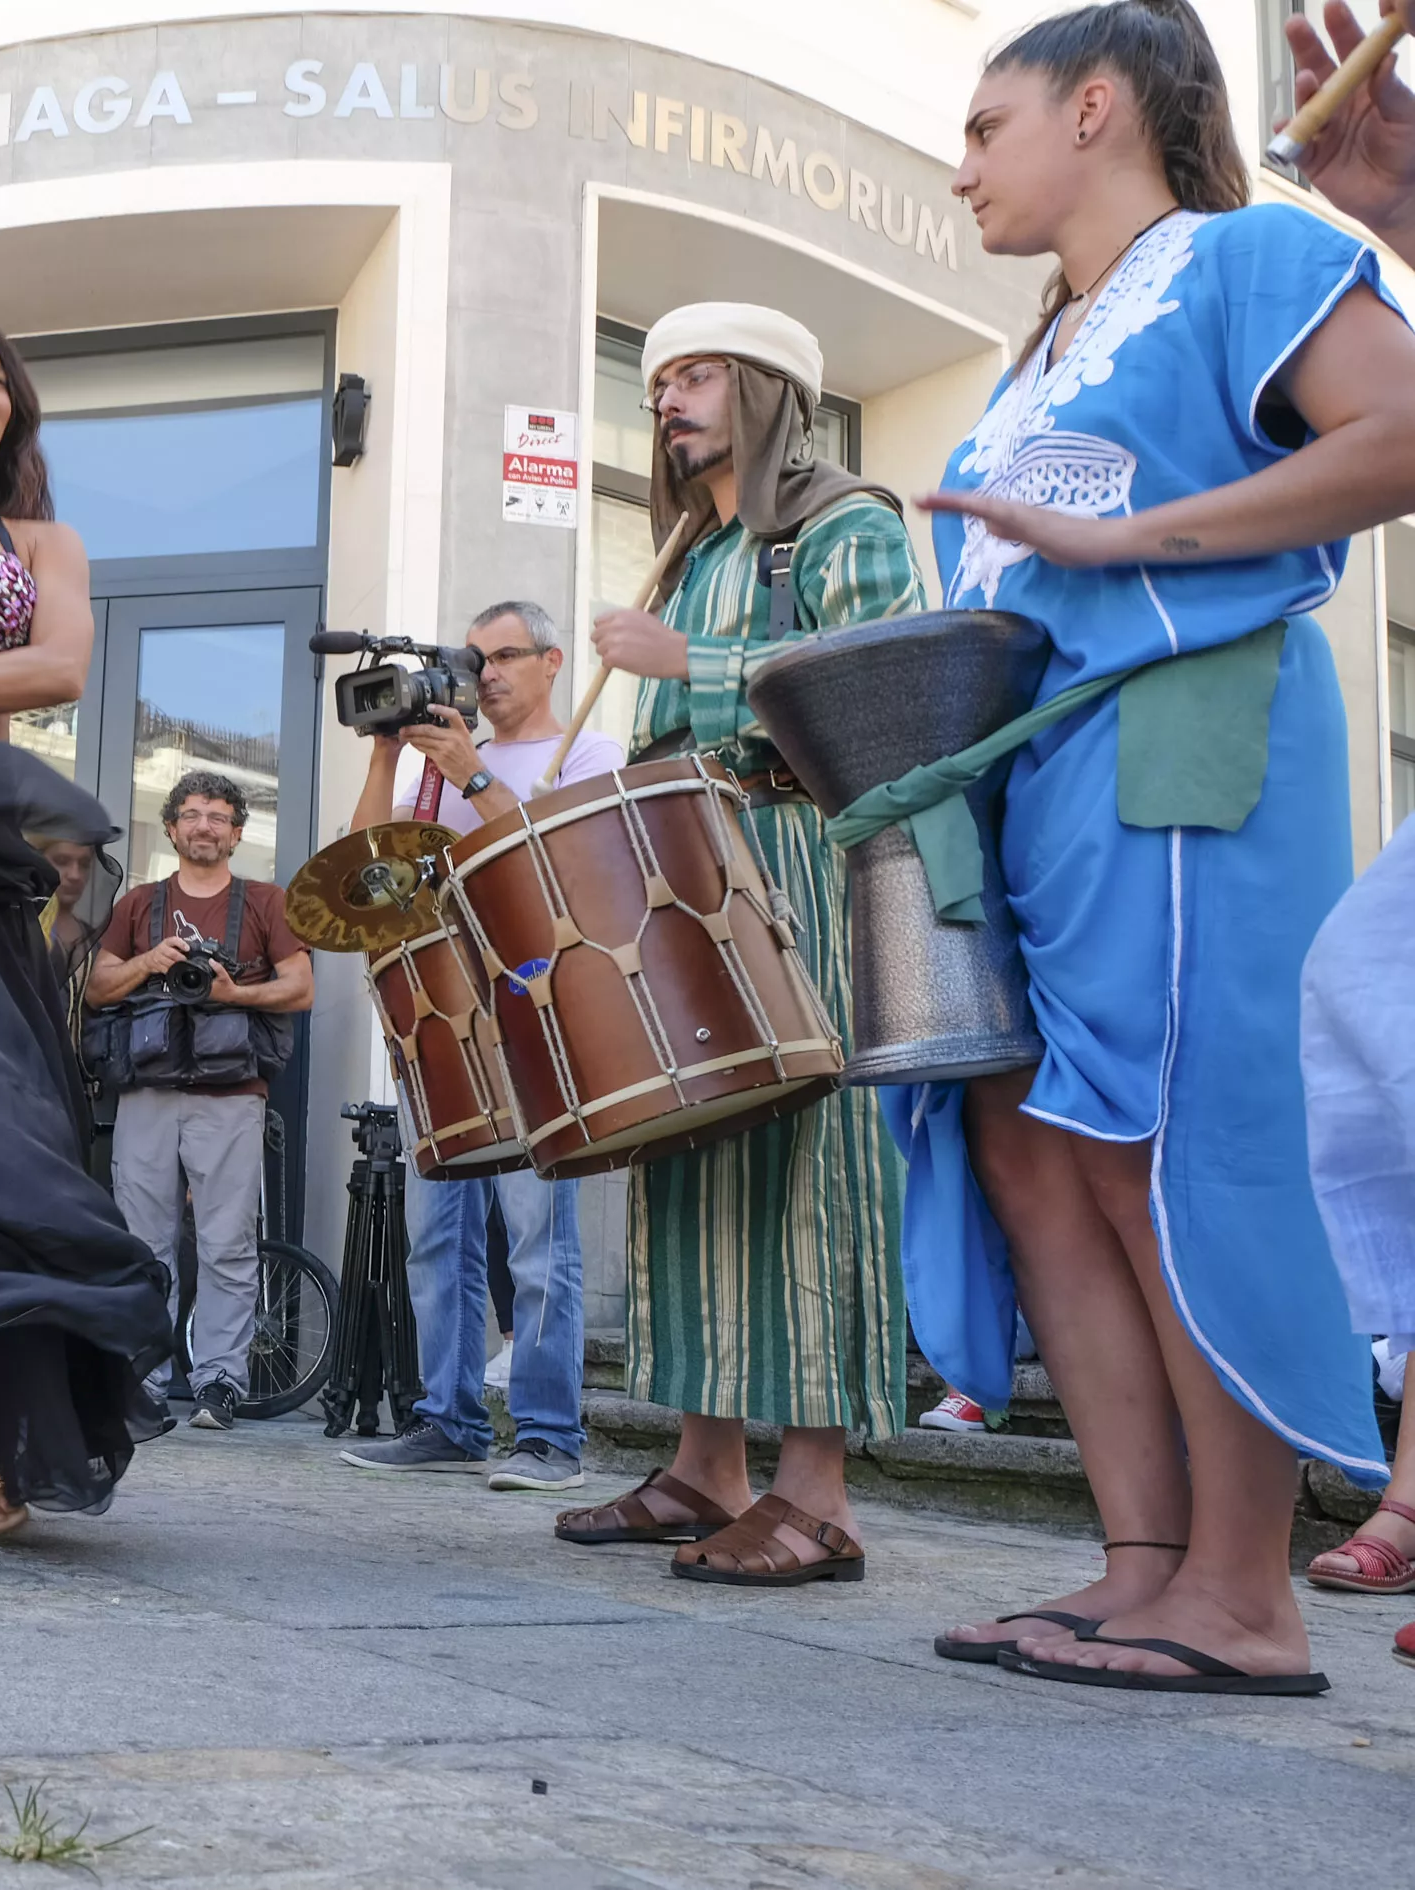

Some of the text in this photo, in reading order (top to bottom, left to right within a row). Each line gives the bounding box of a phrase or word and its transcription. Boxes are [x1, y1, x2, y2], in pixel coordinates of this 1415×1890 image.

[281, 59, 540, 131] SALUS
[568, 80, 958, 272] INFIRMORUM
[508, 456, 574, 478] Alarma
[419, 761, 437, 811] Canon
